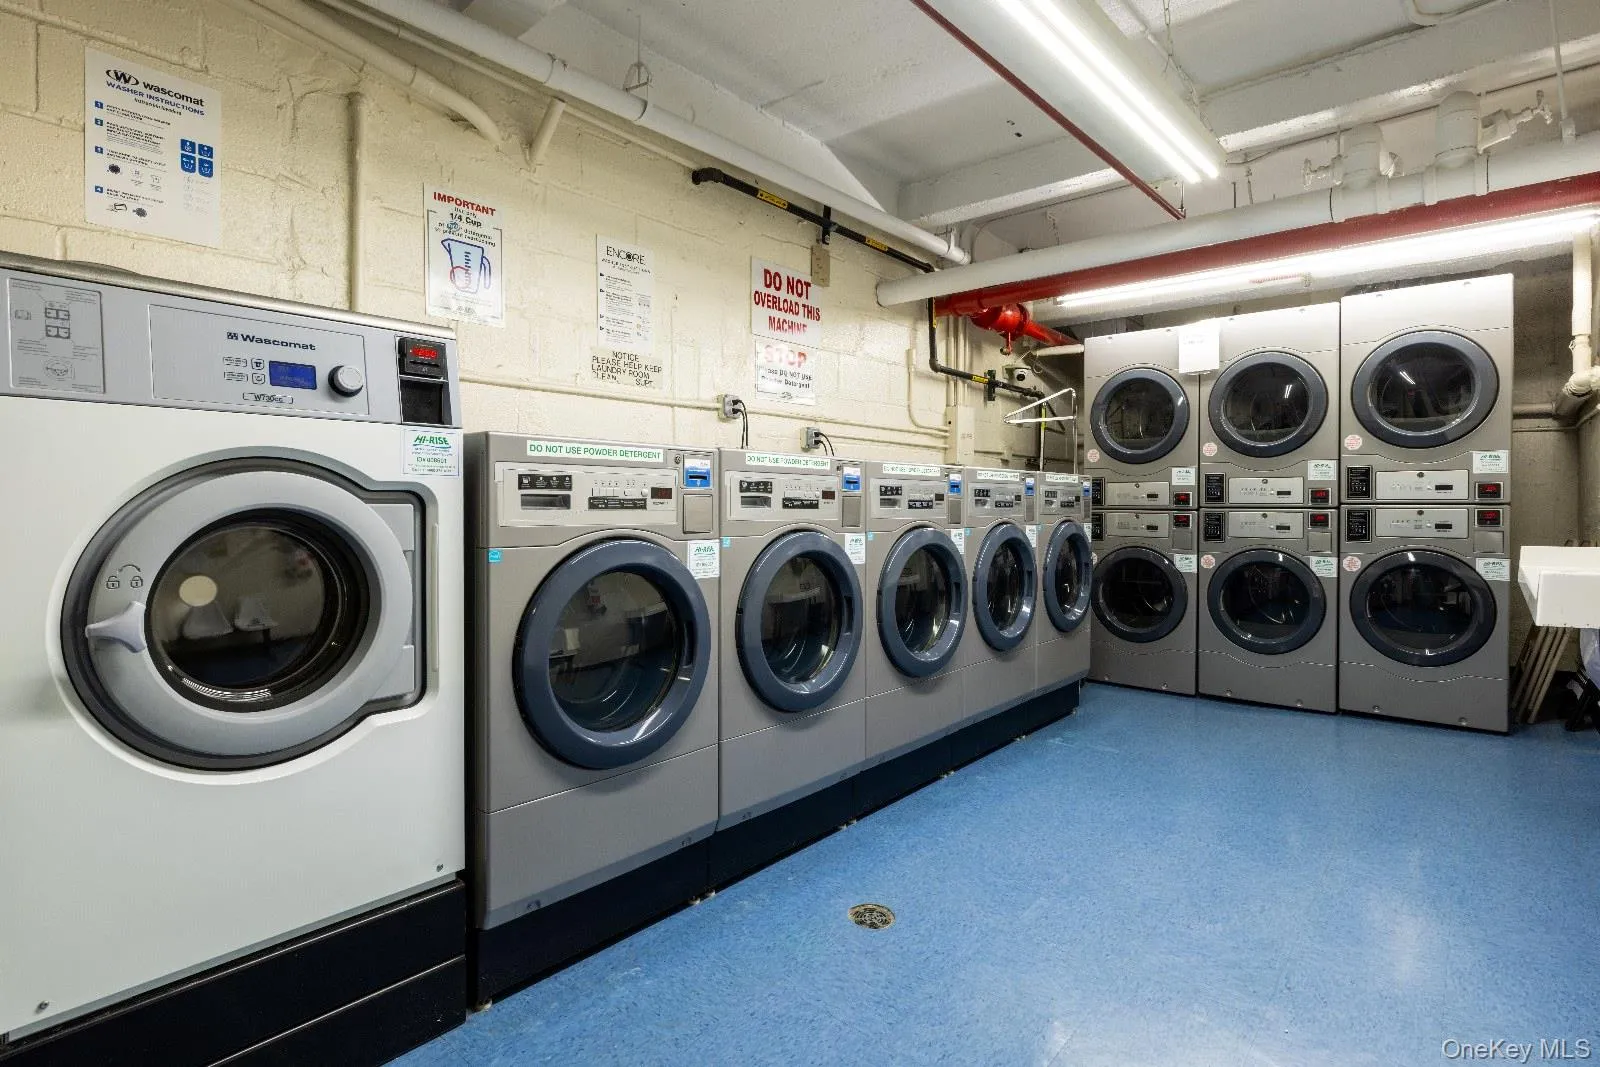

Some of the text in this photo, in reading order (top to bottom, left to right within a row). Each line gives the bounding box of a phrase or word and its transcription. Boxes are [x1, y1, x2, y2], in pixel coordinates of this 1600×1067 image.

[106, 80, 144, 98] WASHER
[146, 94, 204, 116] INSTRUCTIONS
[142, 81, 204, 107] wascomat
[434, 192, 496, 216] IMPORTANT
[450, 213, 462, 222] 1/4
[466, 217, 482, 228] Cup
[606, 245, 645, 265] ENCORE
[764, 268, 811, 300] DO NOT
[754, 290, 820, 321] OVERLOAD THIS
[769, 316, 807, 335] MACHINE
[241, 333, 316, 351] Wascomat
[592, 356, 662, 373] PLEASE HELP KEEP
[613, 351, 639, 362] NOTICE
[764, 344, 806, 368] STOP
[592, 364, 650, 379] LAUNDRY ROOM
[414, 434, 449, 445] HI-RISE
[584, 448, 618, 456] POWDER
[620, 450, 661, 459] DETERGENT
